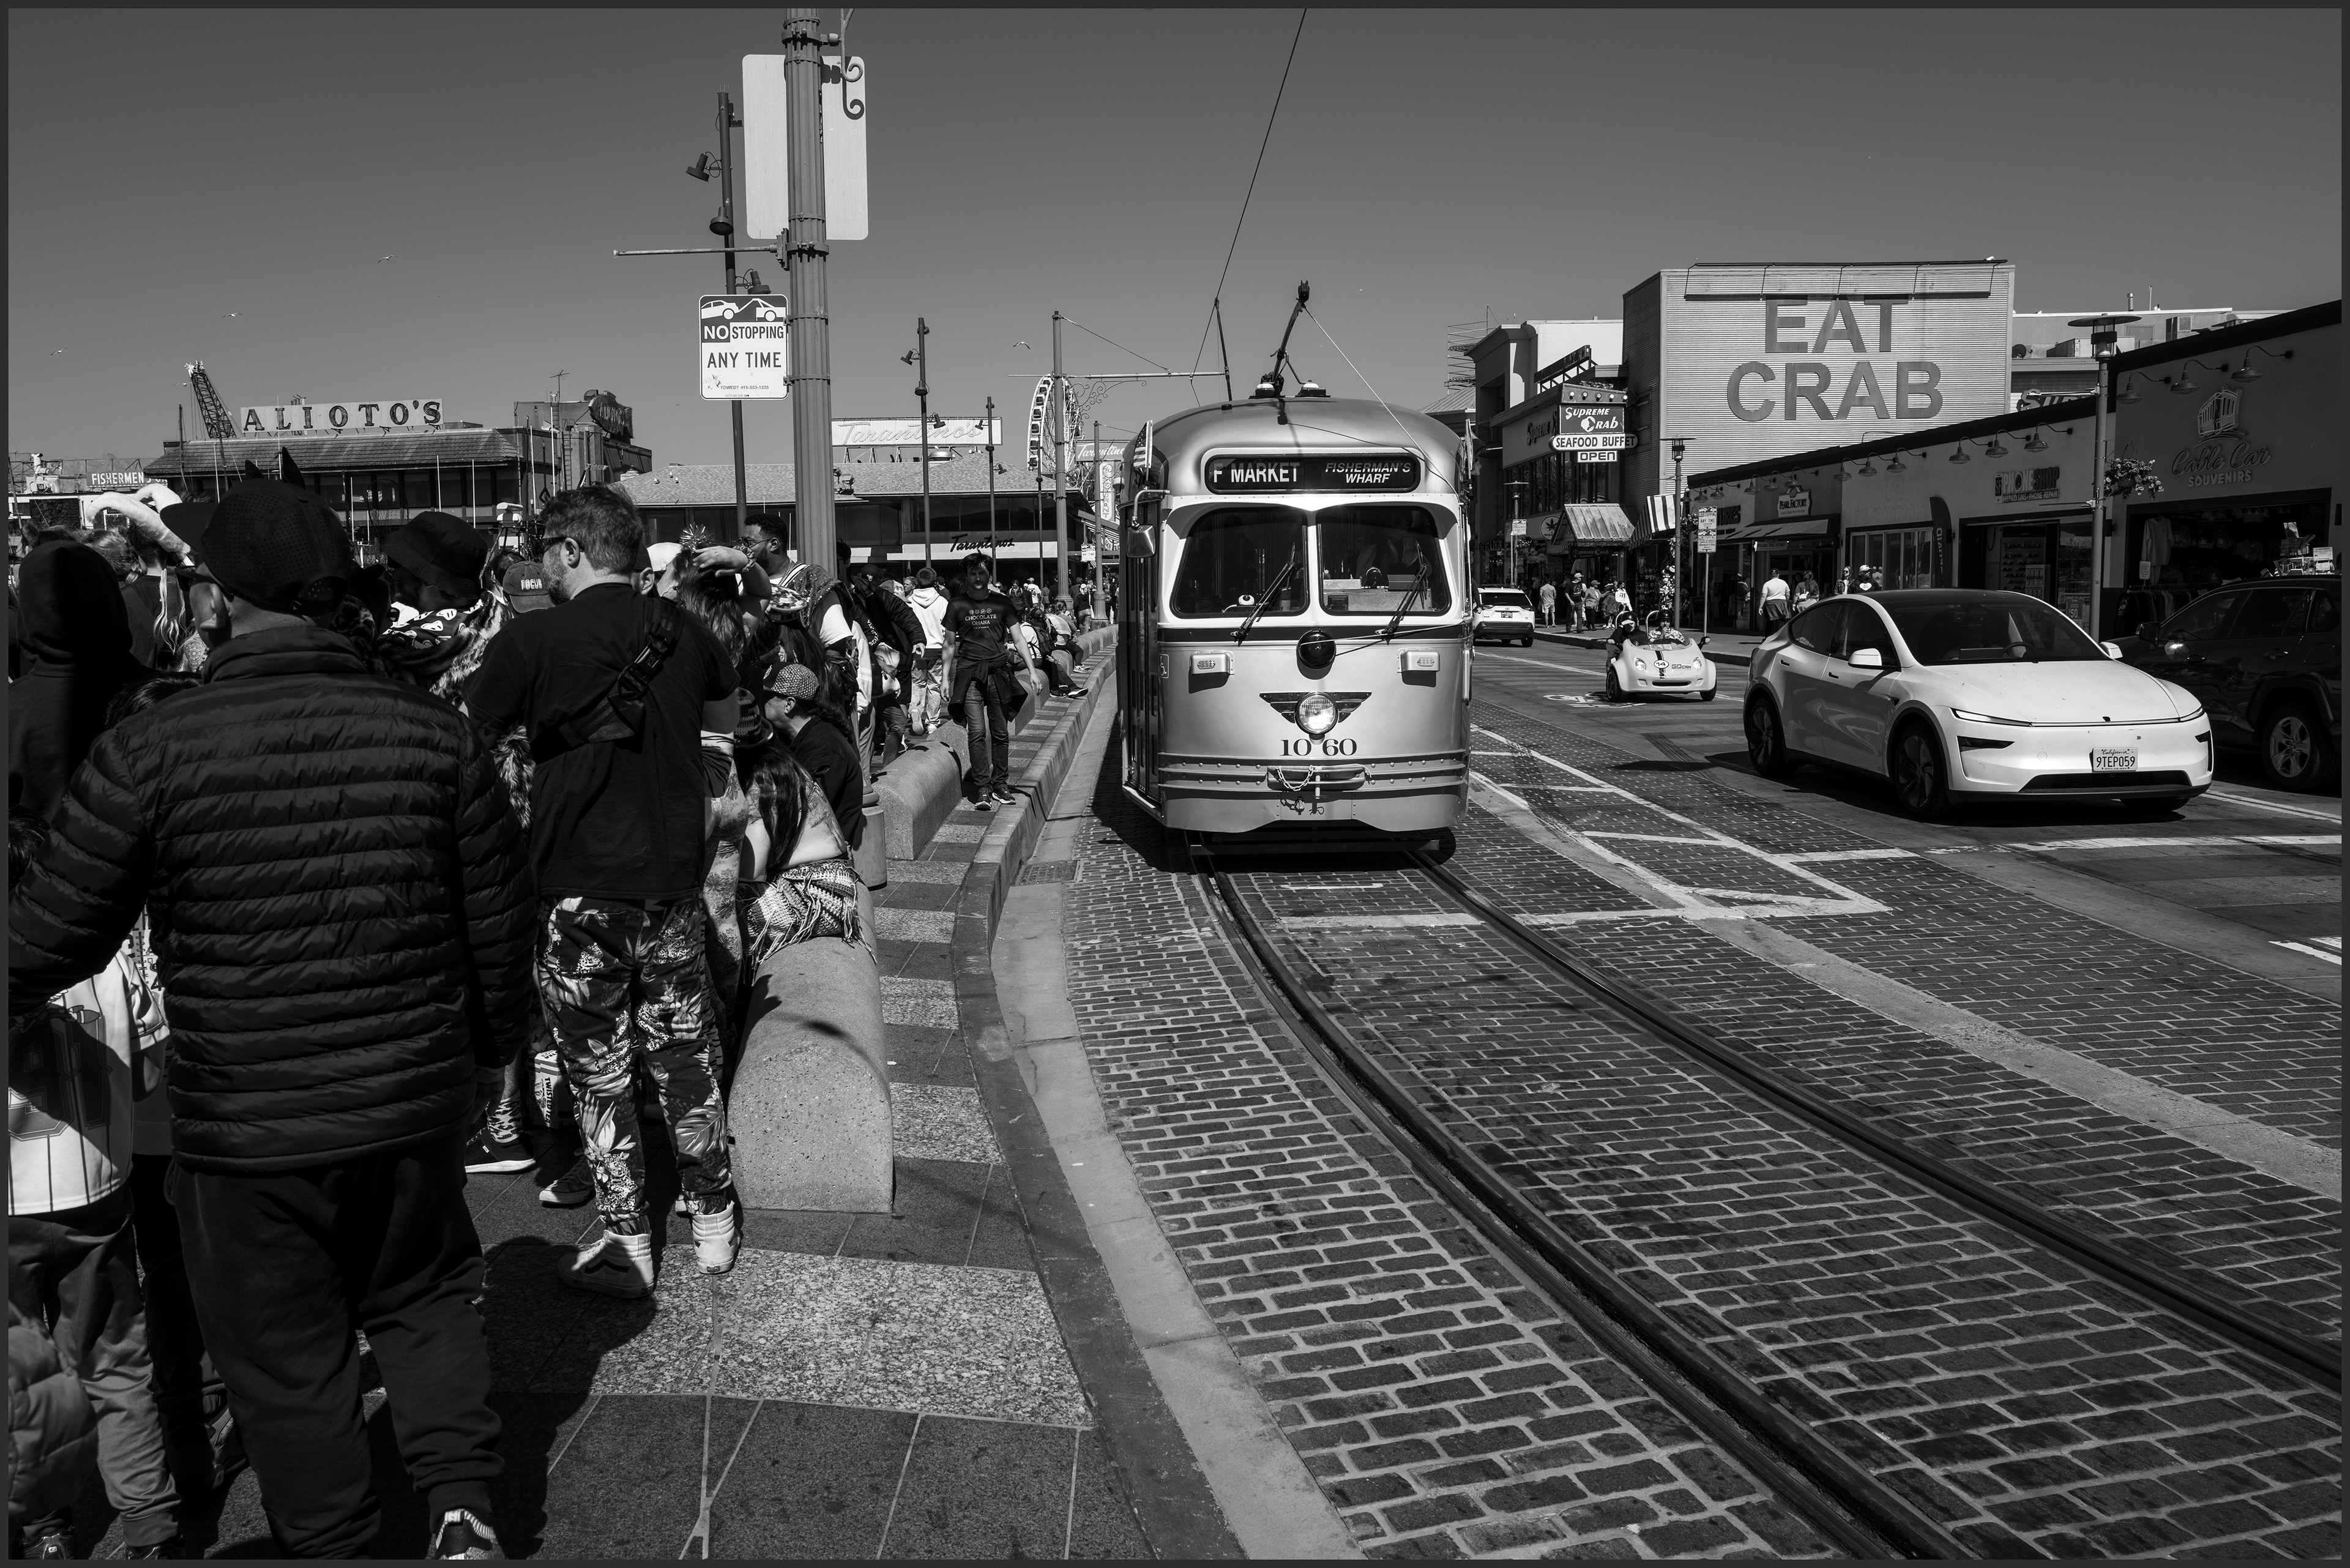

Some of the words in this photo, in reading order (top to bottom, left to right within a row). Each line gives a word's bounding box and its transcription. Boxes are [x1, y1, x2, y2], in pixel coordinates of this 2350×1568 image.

[1766, 294, 1909, 353] EAT
[703, 325, 729, 340] NO
[731, 325, 784, 340] STOPPING
[707, 352, 739, 368] ANY
[745, 351, 781, 367] TIME
[1727, 361, 1943, 421] CRAB
[244, 400, 441, 431] ALIOTO'S
[1565, 407, 1610, 420] SUPREME
[838, 421, 982, 446] Tarantino's
[1556, 437, 1598, 447] SEAFOOD
[1602, 436, 1635, 446] BUFFET
[1580, 452, 1616, 461] OPEN
[2171, 444, 2226, 476] Cable
[2229, 441, 2272, 469] Car
[91, 472, 152, 485] FISHERMEN
[1213, 463, 1223, 483] F
[1231, 462, 1300, 483] MARKET
[1325, 462, 1412, 472] FISHERMAN'S
[1346, 473, 1390, 483] WHARF
[2188, 469, 2253, 487] SOUVENIRS
[1995, 480, 2002, 493] SF
[1779, 501, 1791, 509] PEARL
[1790, 498, 1807, 509] FACTORY
[521, 578, 542, 591] FOCUS
[2096, 756, 2135, 767] 9TEP059
[545, 1077, 553, 1110] TWISTED
